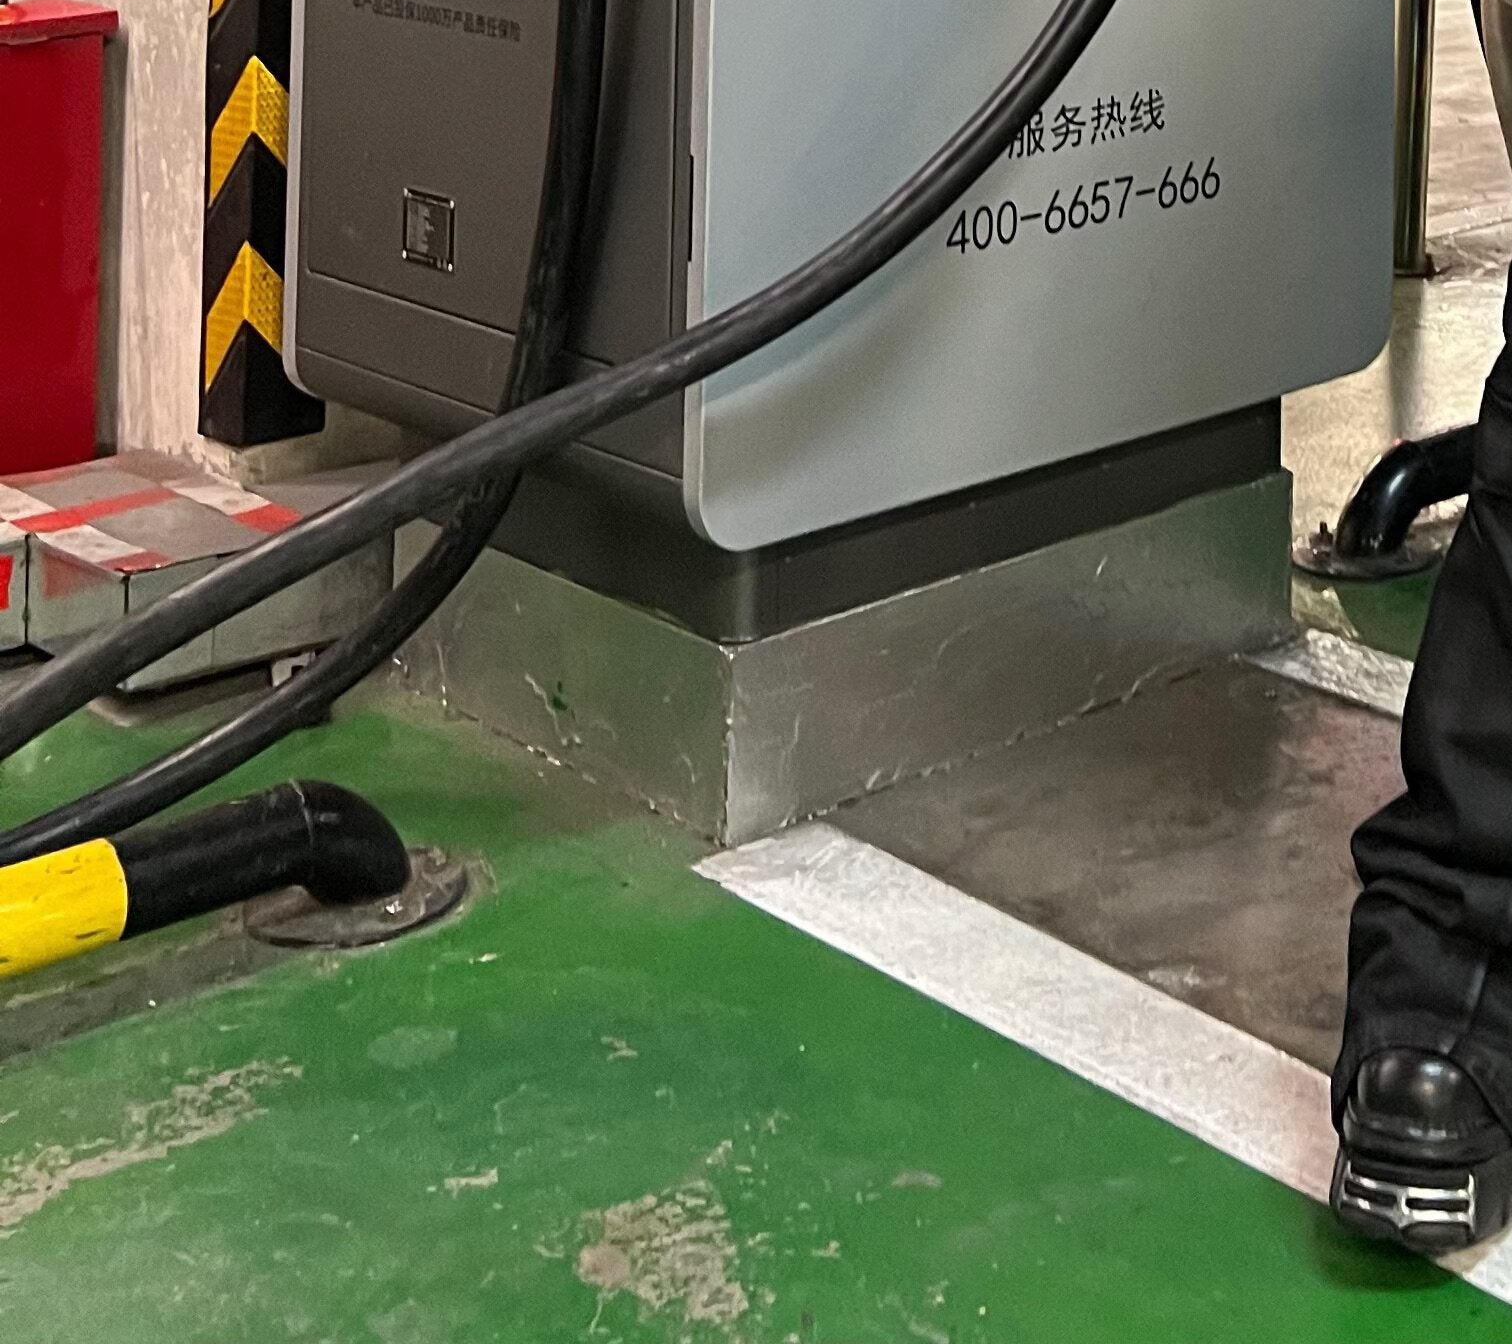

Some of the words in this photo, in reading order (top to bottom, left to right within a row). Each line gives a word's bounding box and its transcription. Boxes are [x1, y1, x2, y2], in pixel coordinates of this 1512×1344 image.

[1008, 88, 1166, 159] 服务热线
[945, 156, 1221, 255] 400-6657-666
